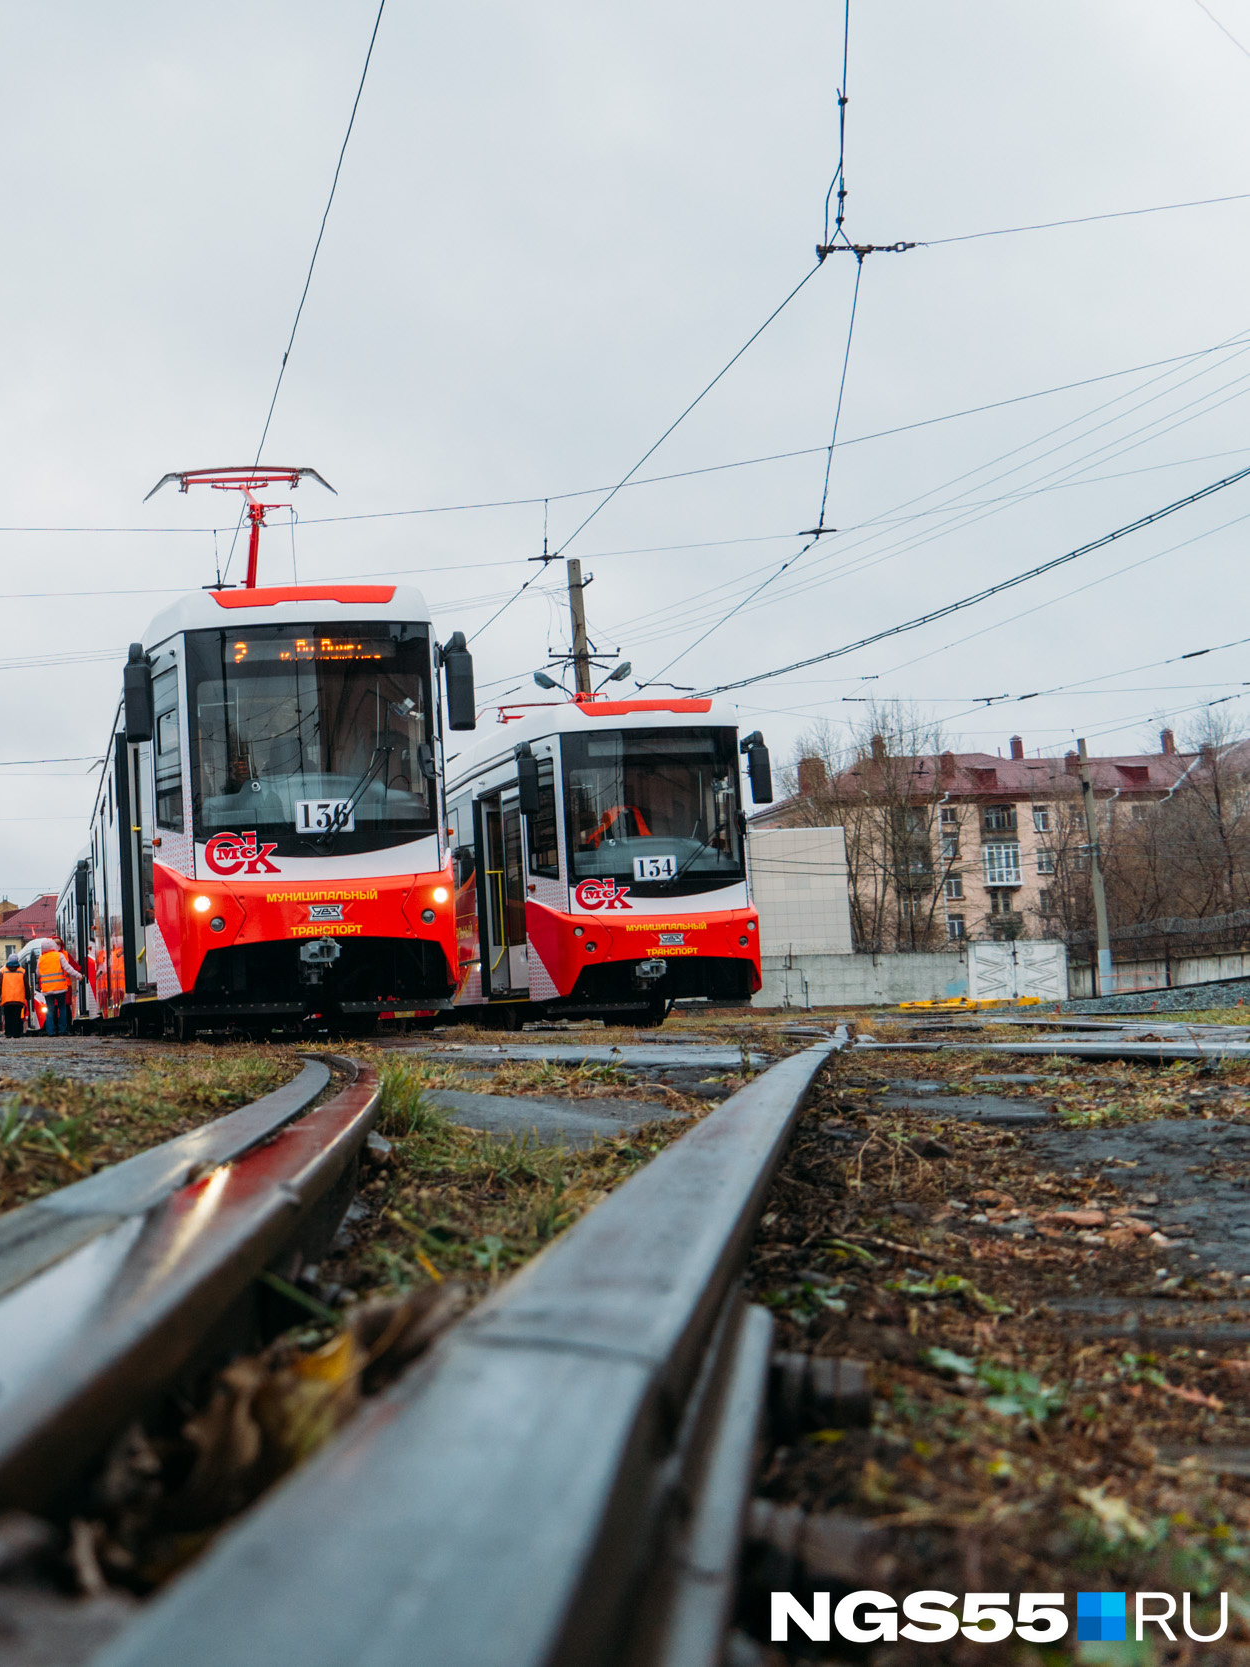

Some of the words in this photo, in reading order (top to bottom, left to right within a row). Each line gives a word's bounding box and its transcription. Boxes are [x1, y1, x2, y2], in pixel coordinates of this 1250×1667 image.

[301, 803, 349, 829] 136
[638, 858, 674, 878] 134
[266, 888, 378, 903] МУНИЦИПАЛЬНЫЙ
[290, 924, 363, 937] ТРАНСПОРТ
[625, 921, 707, 932] МУНИЦИПАЛЬНЫЙ
[646, 947, 698, 956] ТРАНСПОРТ
